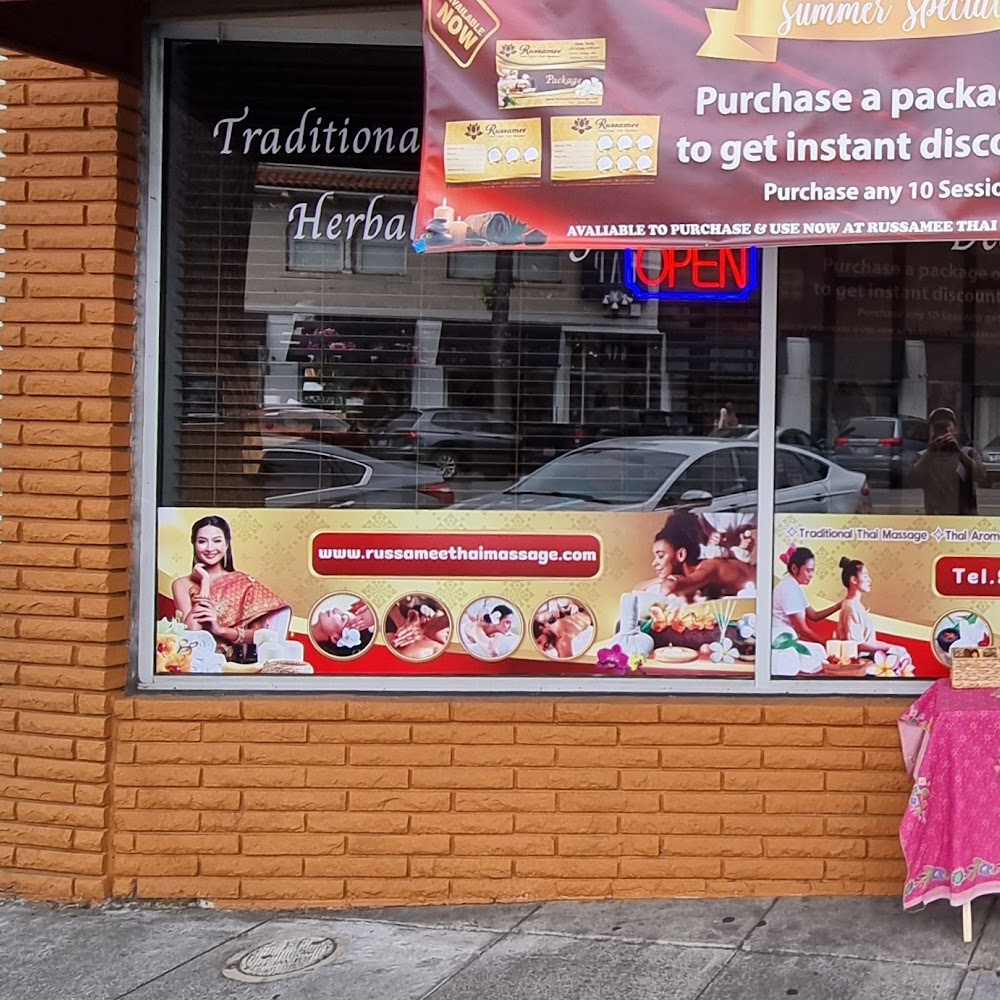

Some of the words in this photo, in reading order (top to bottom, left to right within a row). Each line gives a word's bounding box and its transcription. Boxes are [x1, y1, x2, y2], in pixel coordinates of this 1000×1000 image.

[436, 2, 479, 50] NOW
[696, 83, 852, 115] Purchase
[861, 87, 881, 111] a
[213, 106, 420, 155] Traditiona
[486, 123, 527, 135] Russamee
[595, 118, 640, 129] Russamee
[676, 135, 712, 163] to
[720, 134, 777, 170] get
[786, 131, 911, 162] instant
[763, 181, 859, 201] Purchase
[863, 184, 903, 205] any
[908, 181, 934, 200] 10
[567, 224, 646, 237] AVALIABLE
[648, 223, 667, 236] TO
[671, 223, 751, 236] PURCHASE
[754, 223, 767, 235] &
[770, 222, 800, 235] USE
[803, 221, 841, 234] NOW
[841, 221, 865, 233] AT
[867, 219, 953, 233] RUSSAMEE
[956, 219, 998, 232] THAI
[636, 246, 746, 288] OPEN
[799, 528, 853, 539] Traditional
[857, 529, 878, 539] Thai
[882, 530, 927, 542] Massage
[946, 530, 967, 540] Thai
[318, 545, 597, 565] www.russameethaimassage.com
